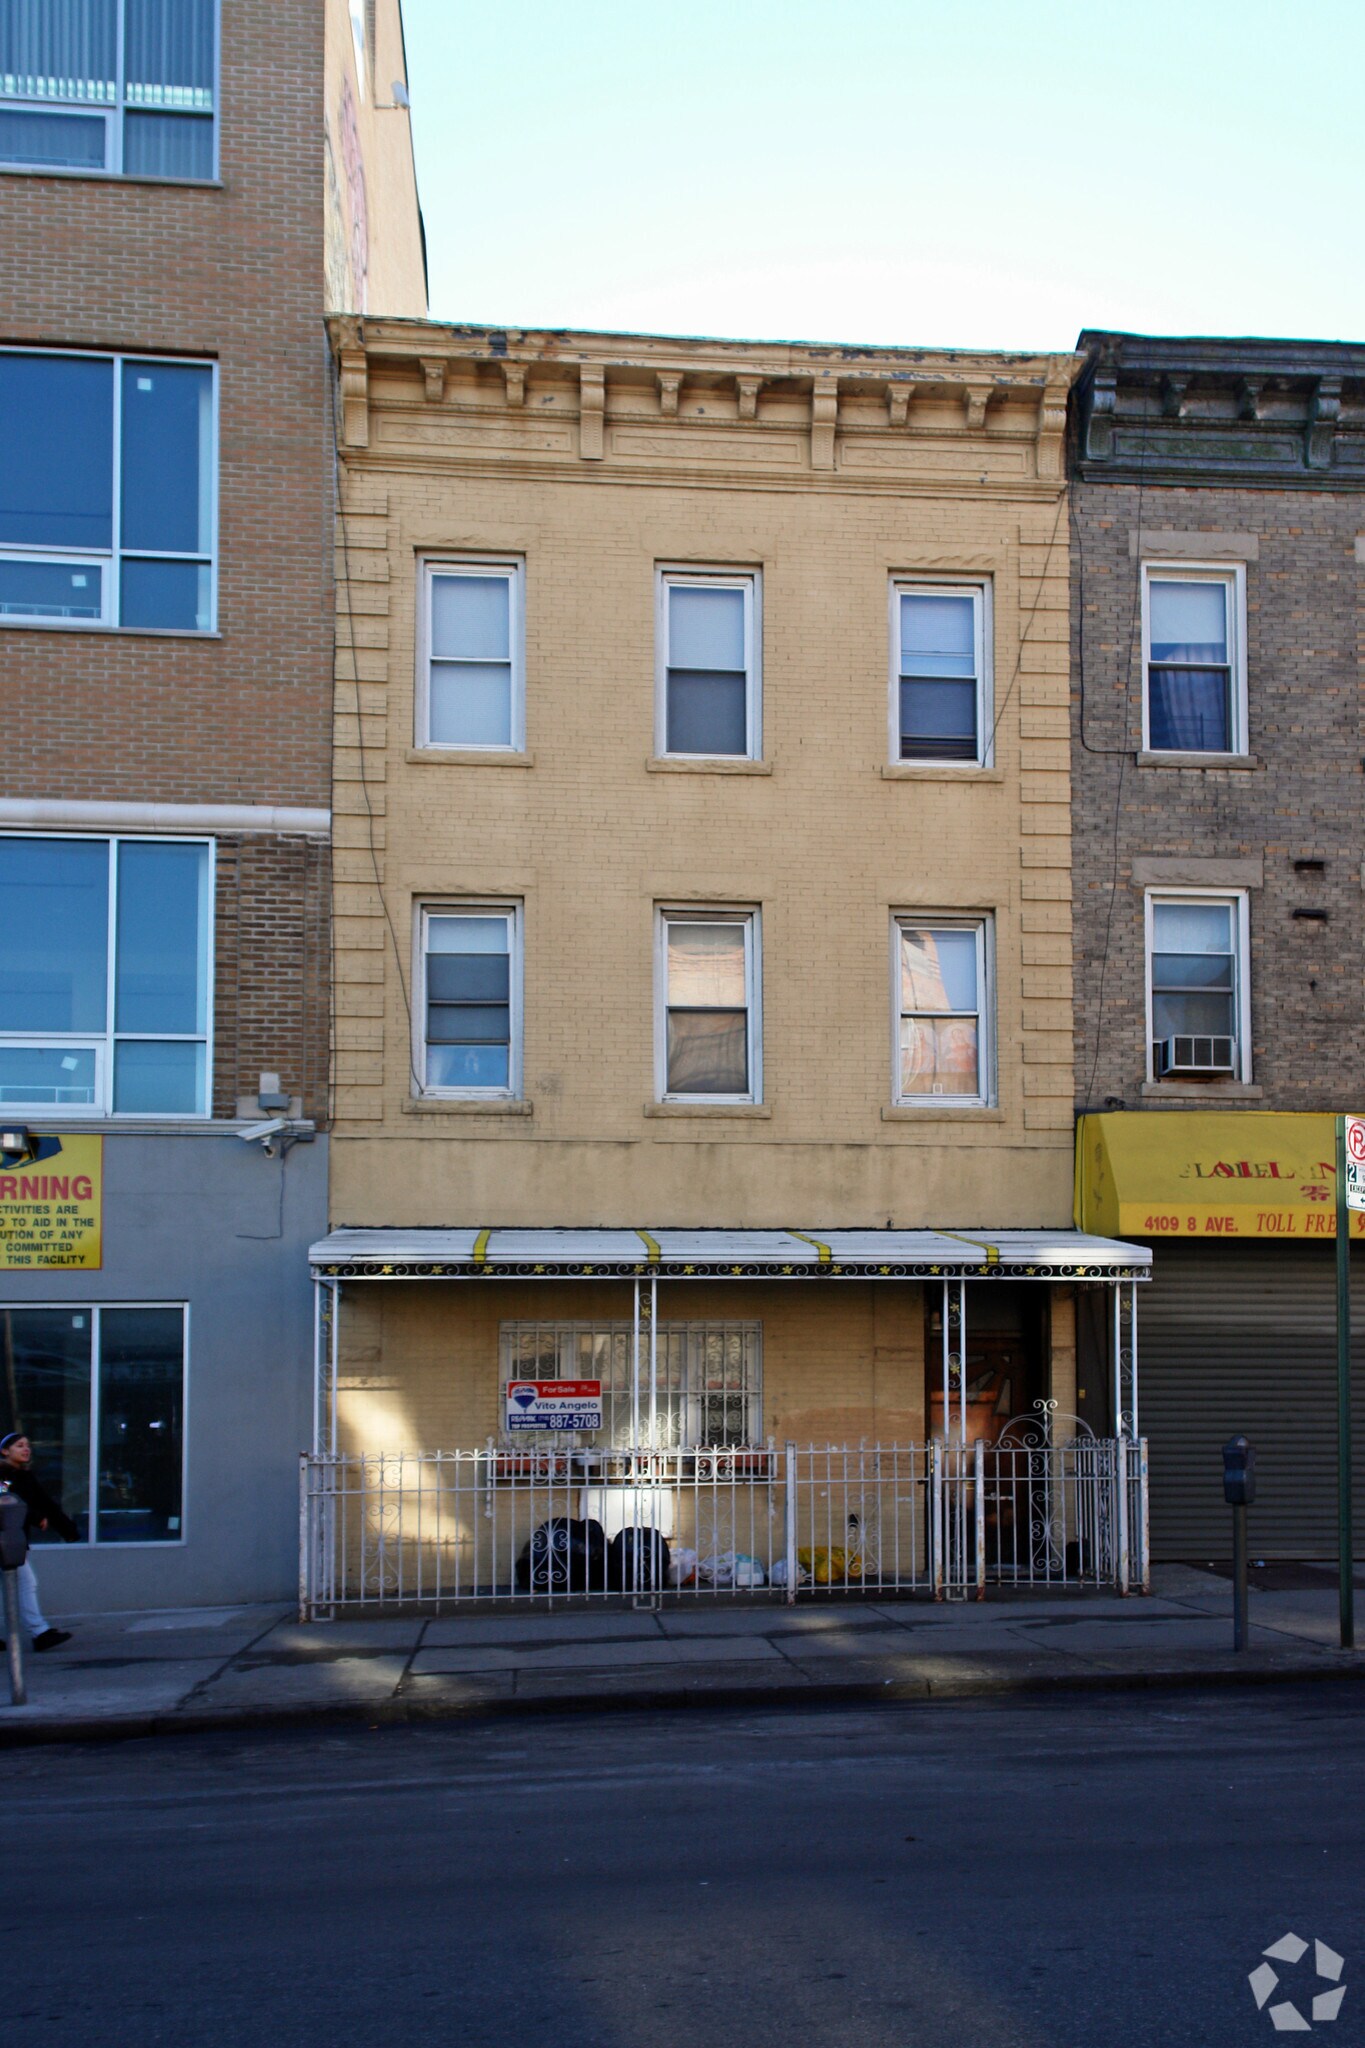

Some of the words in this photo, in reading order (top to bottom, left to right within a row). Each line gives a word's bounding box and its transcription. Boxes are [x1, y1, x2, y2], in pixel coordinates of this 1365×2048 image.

[0, 1205, 50, 1214] TIVITIES
[56, 1205, 78, 1214] ARE
[12, 1218, 26, 1227] TO
[32, 1218, 51, 1227] AID
[56, 1218, 67, 1227] IN
[73, 1218, 94, 1227] THE
[1144, 1216, 1179, 1231] 4109
[1187, 1216, 1197, 1231] 8
[1205, 1217, 1239, 1232] AVE.
[1256, 1213, 1296, 1232] TOLL
[1304, 1213, 1337, 1233] FRE
[39, 1230, 54, 1239] OF
[60, 1230, 83, 1239] ANY
[6, 1243, 73, 1252] COMMITTED
[6, 1255, 31, 1264] THIS
[37, 1255, 85, 1264] FACILITY
[534, 1402, 556, 1410] Vito
[559, 1401, 598, 1412] Angelo
[549, 1414, 599, 1428] 887-5708
